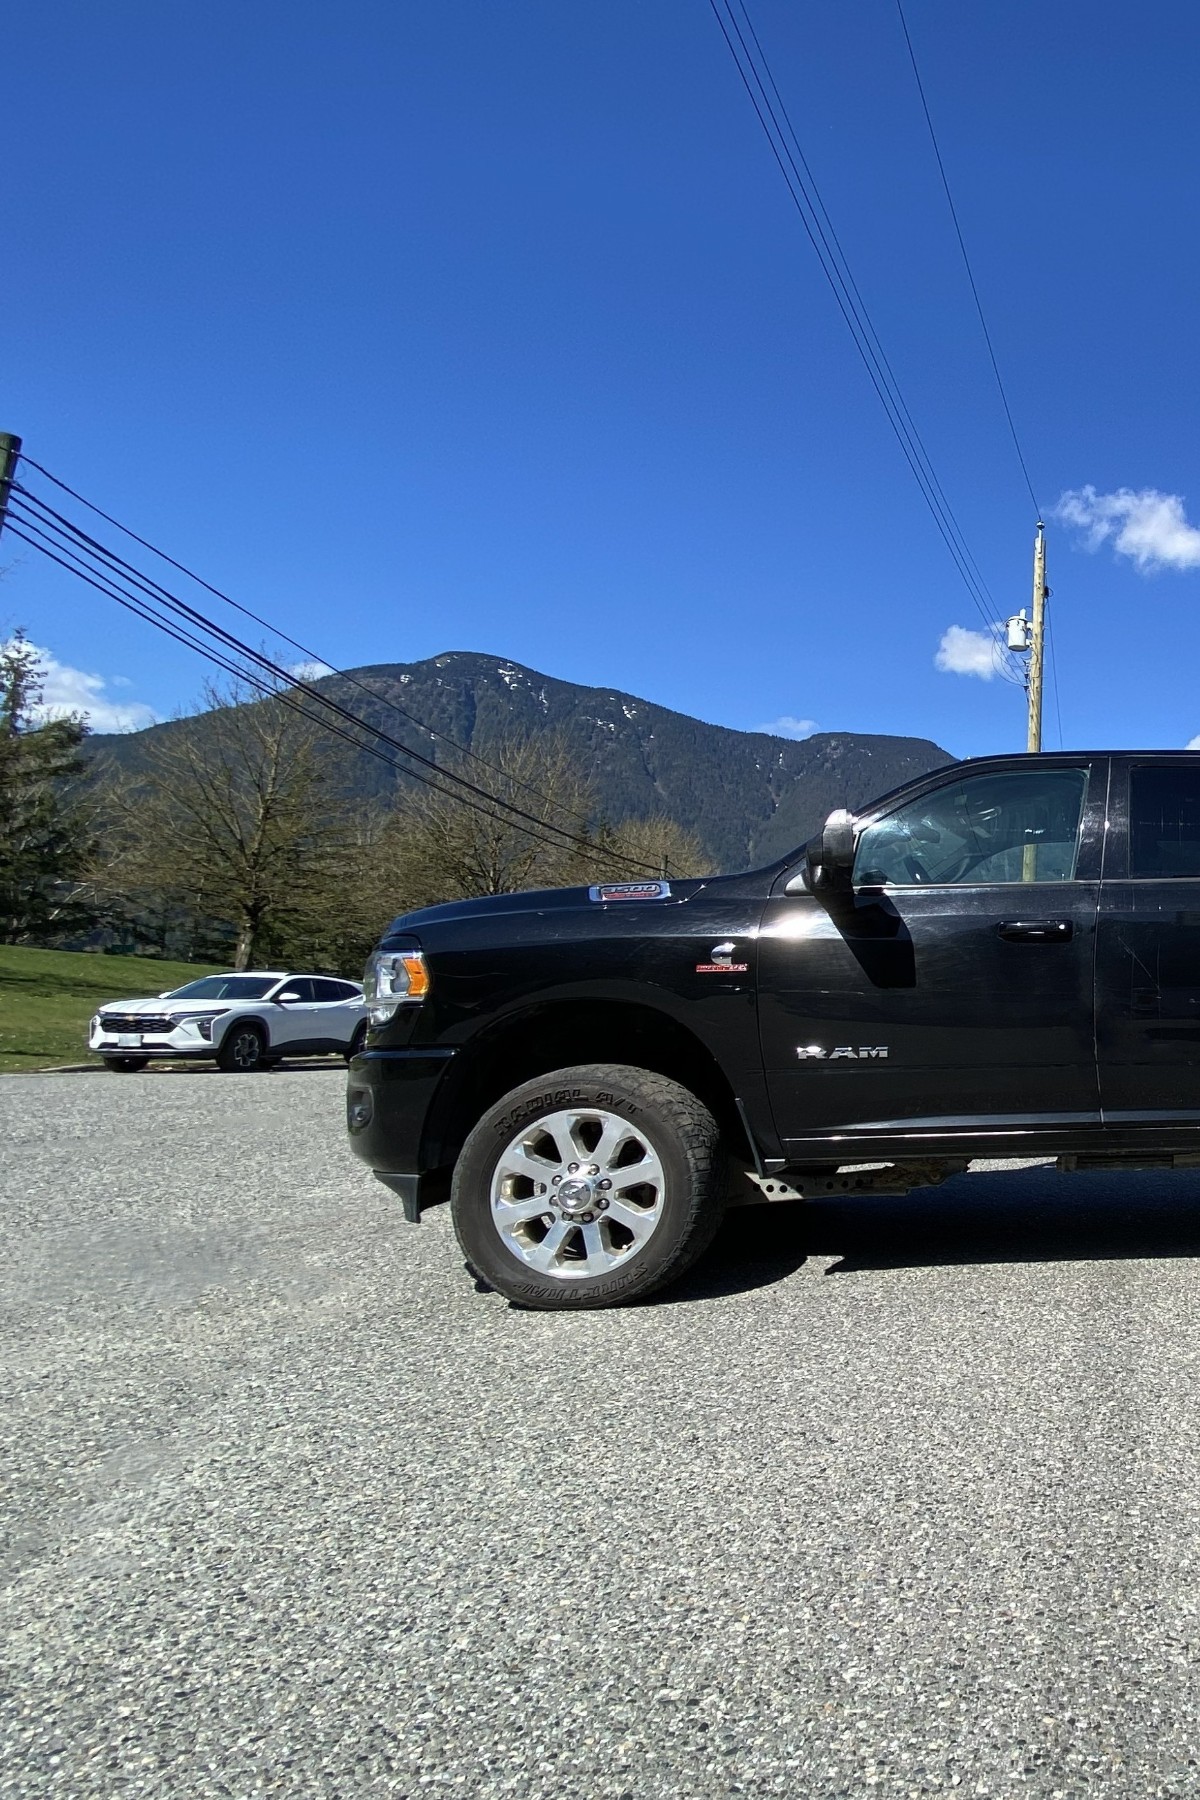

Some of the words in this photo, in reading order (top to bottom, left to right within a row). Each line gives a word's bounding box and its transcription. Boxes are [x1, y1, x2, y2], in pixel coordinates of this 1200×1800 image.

[796, 1046, 889, 1060] RAM
[493, 1088, 589, 1136] RADIAL
[595, 1091, 640, 1115] A/T
